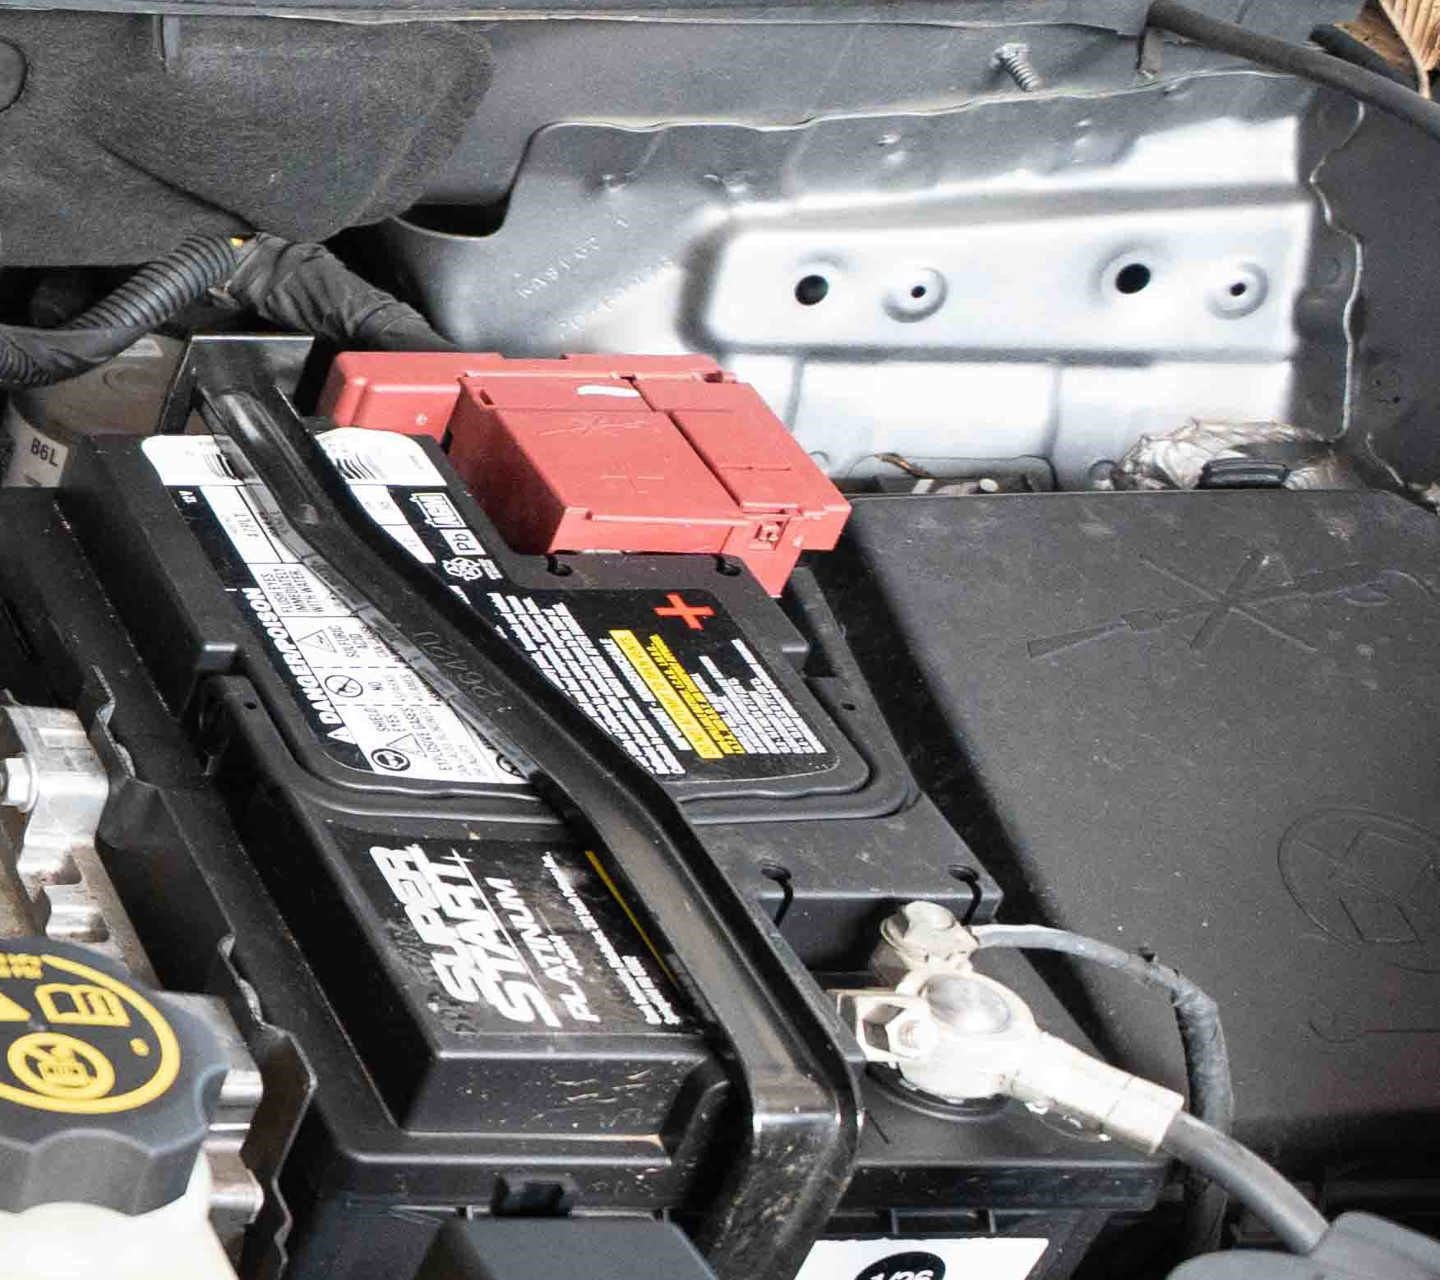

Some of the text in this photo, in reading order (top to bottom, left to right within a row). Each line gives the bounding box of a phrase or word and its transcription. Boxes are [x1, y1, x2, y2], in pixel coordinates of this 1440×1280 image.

[449, 533, 477, 550] Pb
[369, 846, 480, 1002] SUPER
[405, 843, 560, 1027] START
[486, 876, 601, 1023] PLATINUM
